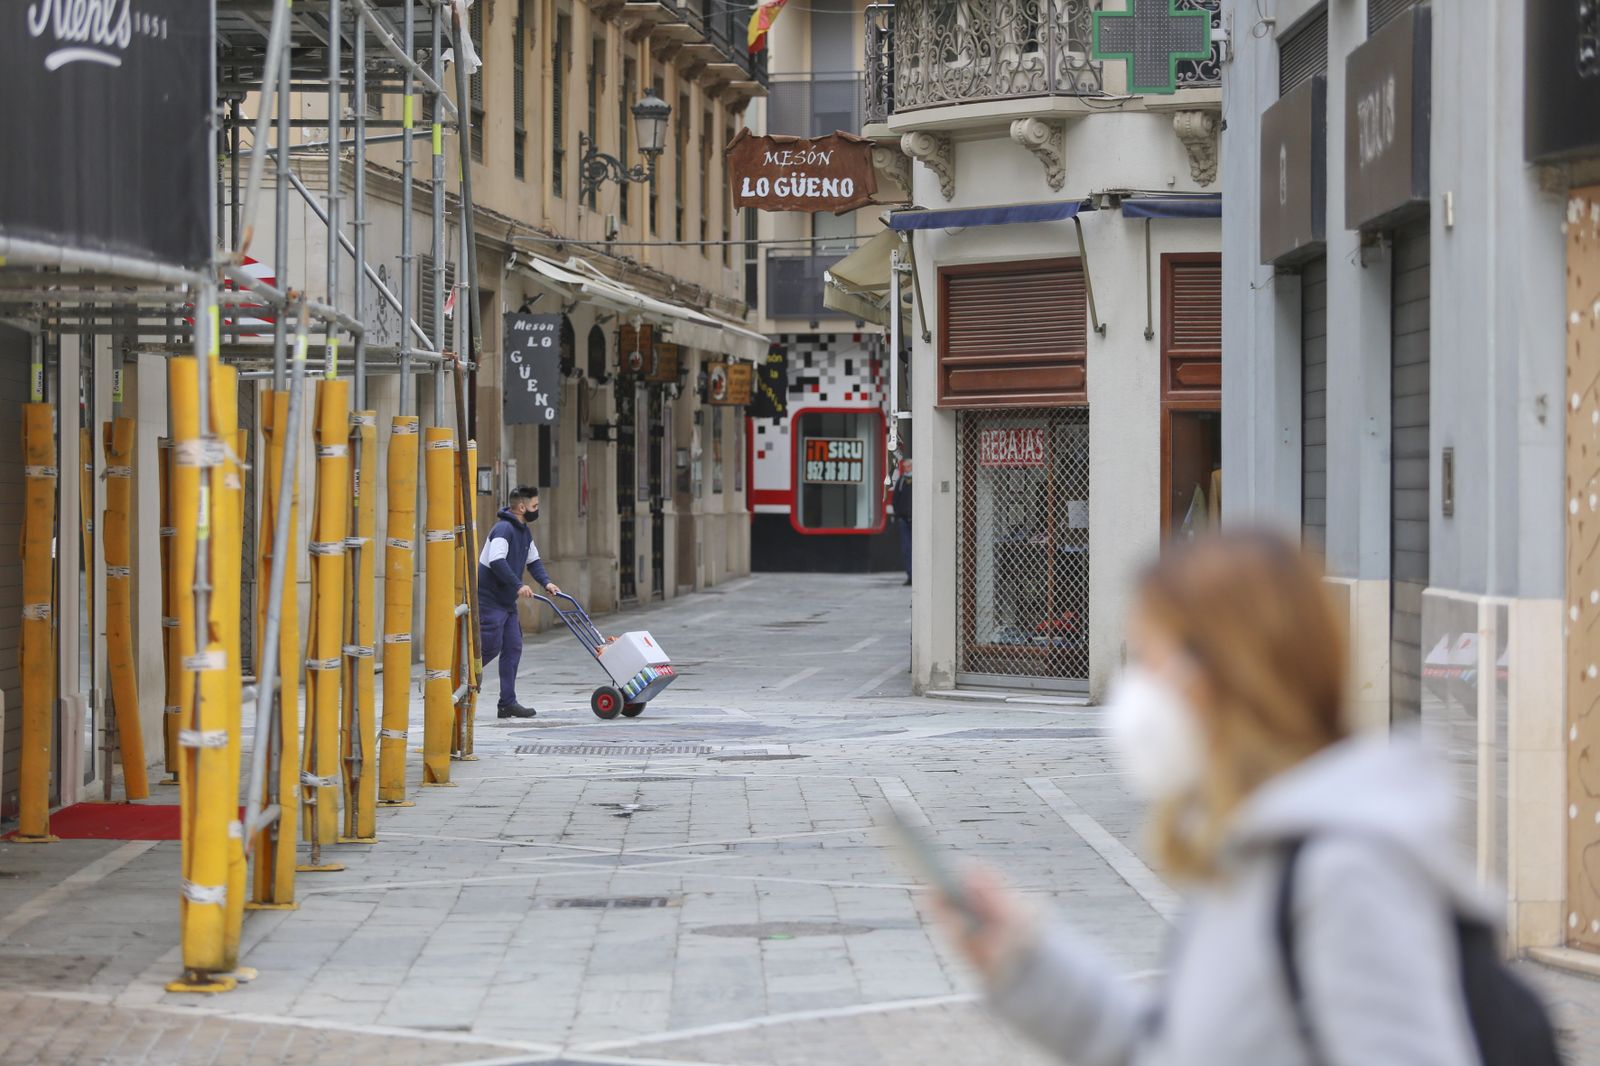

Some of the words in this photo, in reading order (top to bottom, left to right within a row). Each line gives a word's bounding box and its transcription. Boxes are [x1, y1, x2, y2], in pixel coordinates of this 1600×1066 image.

[763, 145, 834, 167] MESÓN
[741, 177, 770, 198] LO
[774, 172, 854, 198] GÜENO
[514, 320, 554, 331] Meson
[527, 336, 552, 348] LO
[510, 351, 555, 420] GÜENO
[981, 430, 1043, 460] REBAJAS
